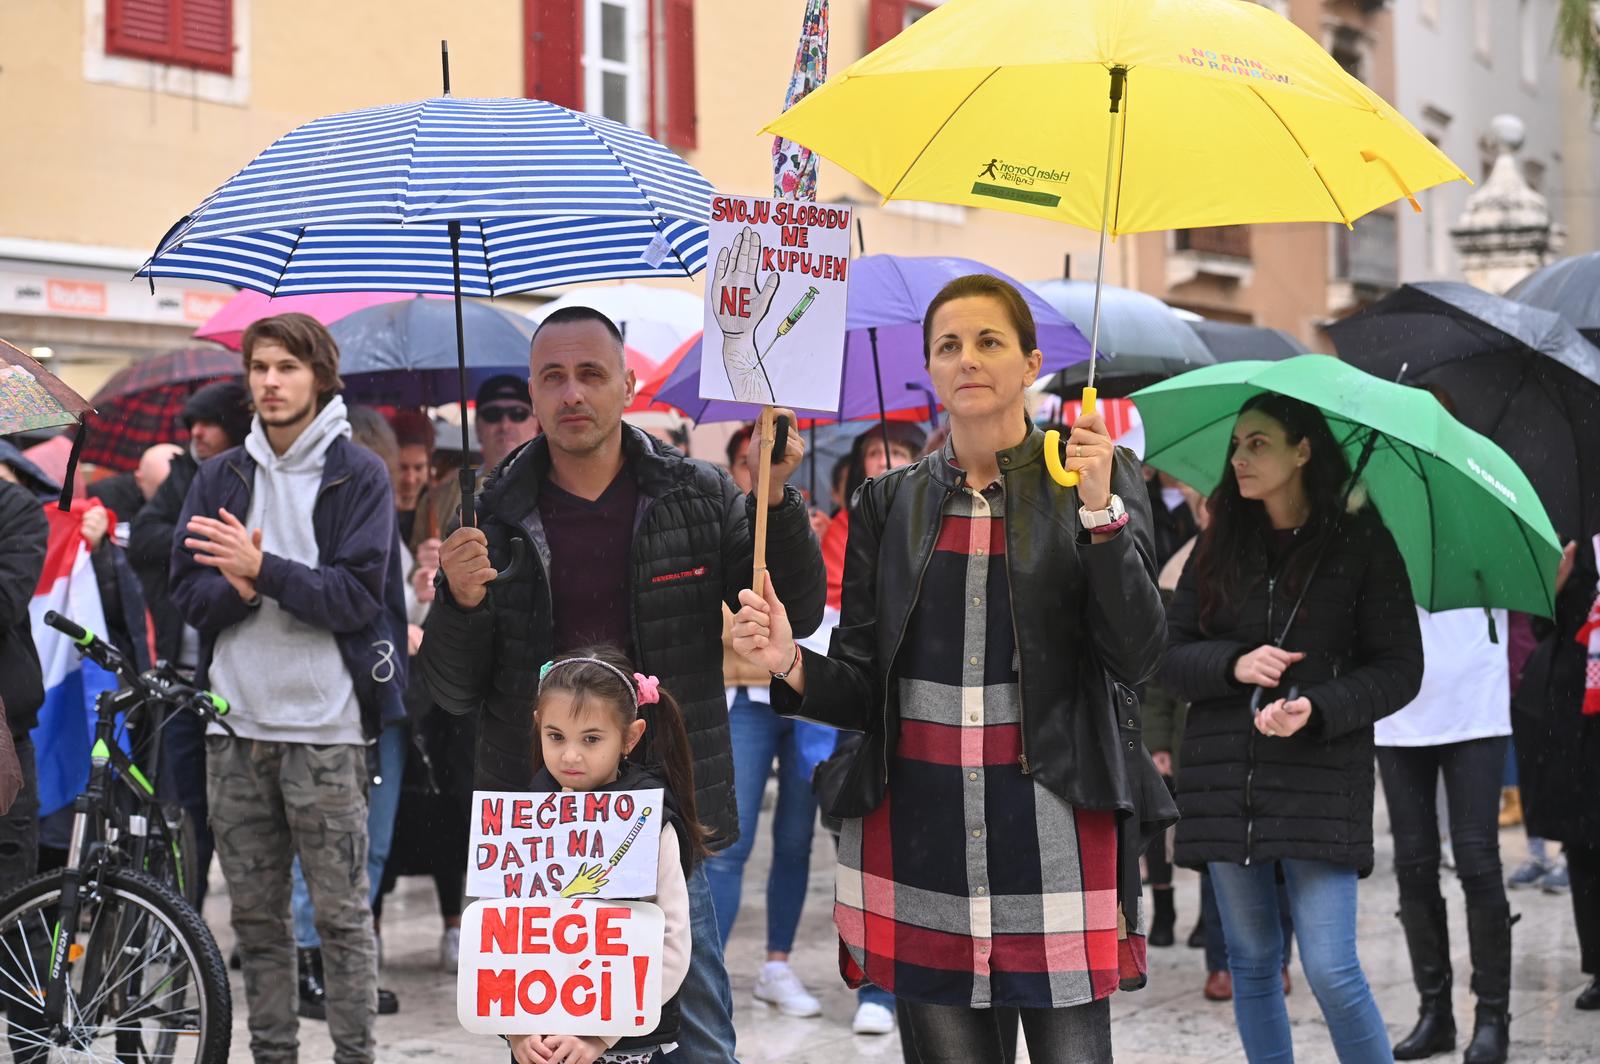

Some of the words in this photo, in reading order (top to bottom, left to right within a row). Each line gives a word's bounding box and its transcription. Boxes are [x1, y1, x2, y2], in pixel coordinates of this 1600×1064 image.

[1178, 54, 1204, 68] NO
[1191, 47, 1217, 61] NO
[713, 198, 770, 223] SVOJU
[772, 204, 848, 229] SLOBODU
[780, 225, 809, 248] NE
[763, 248, 847, 281] KUPUJEM
[719, 285, 751, 318] NE
[481, 792, 635, 836] NEĆEMO
[476, 835, 554, 870] DATI
[567, 828, 604, 858] NA
[503, 863, 564, 898] NAS
[480, 899, 632, 956] NEĆE
